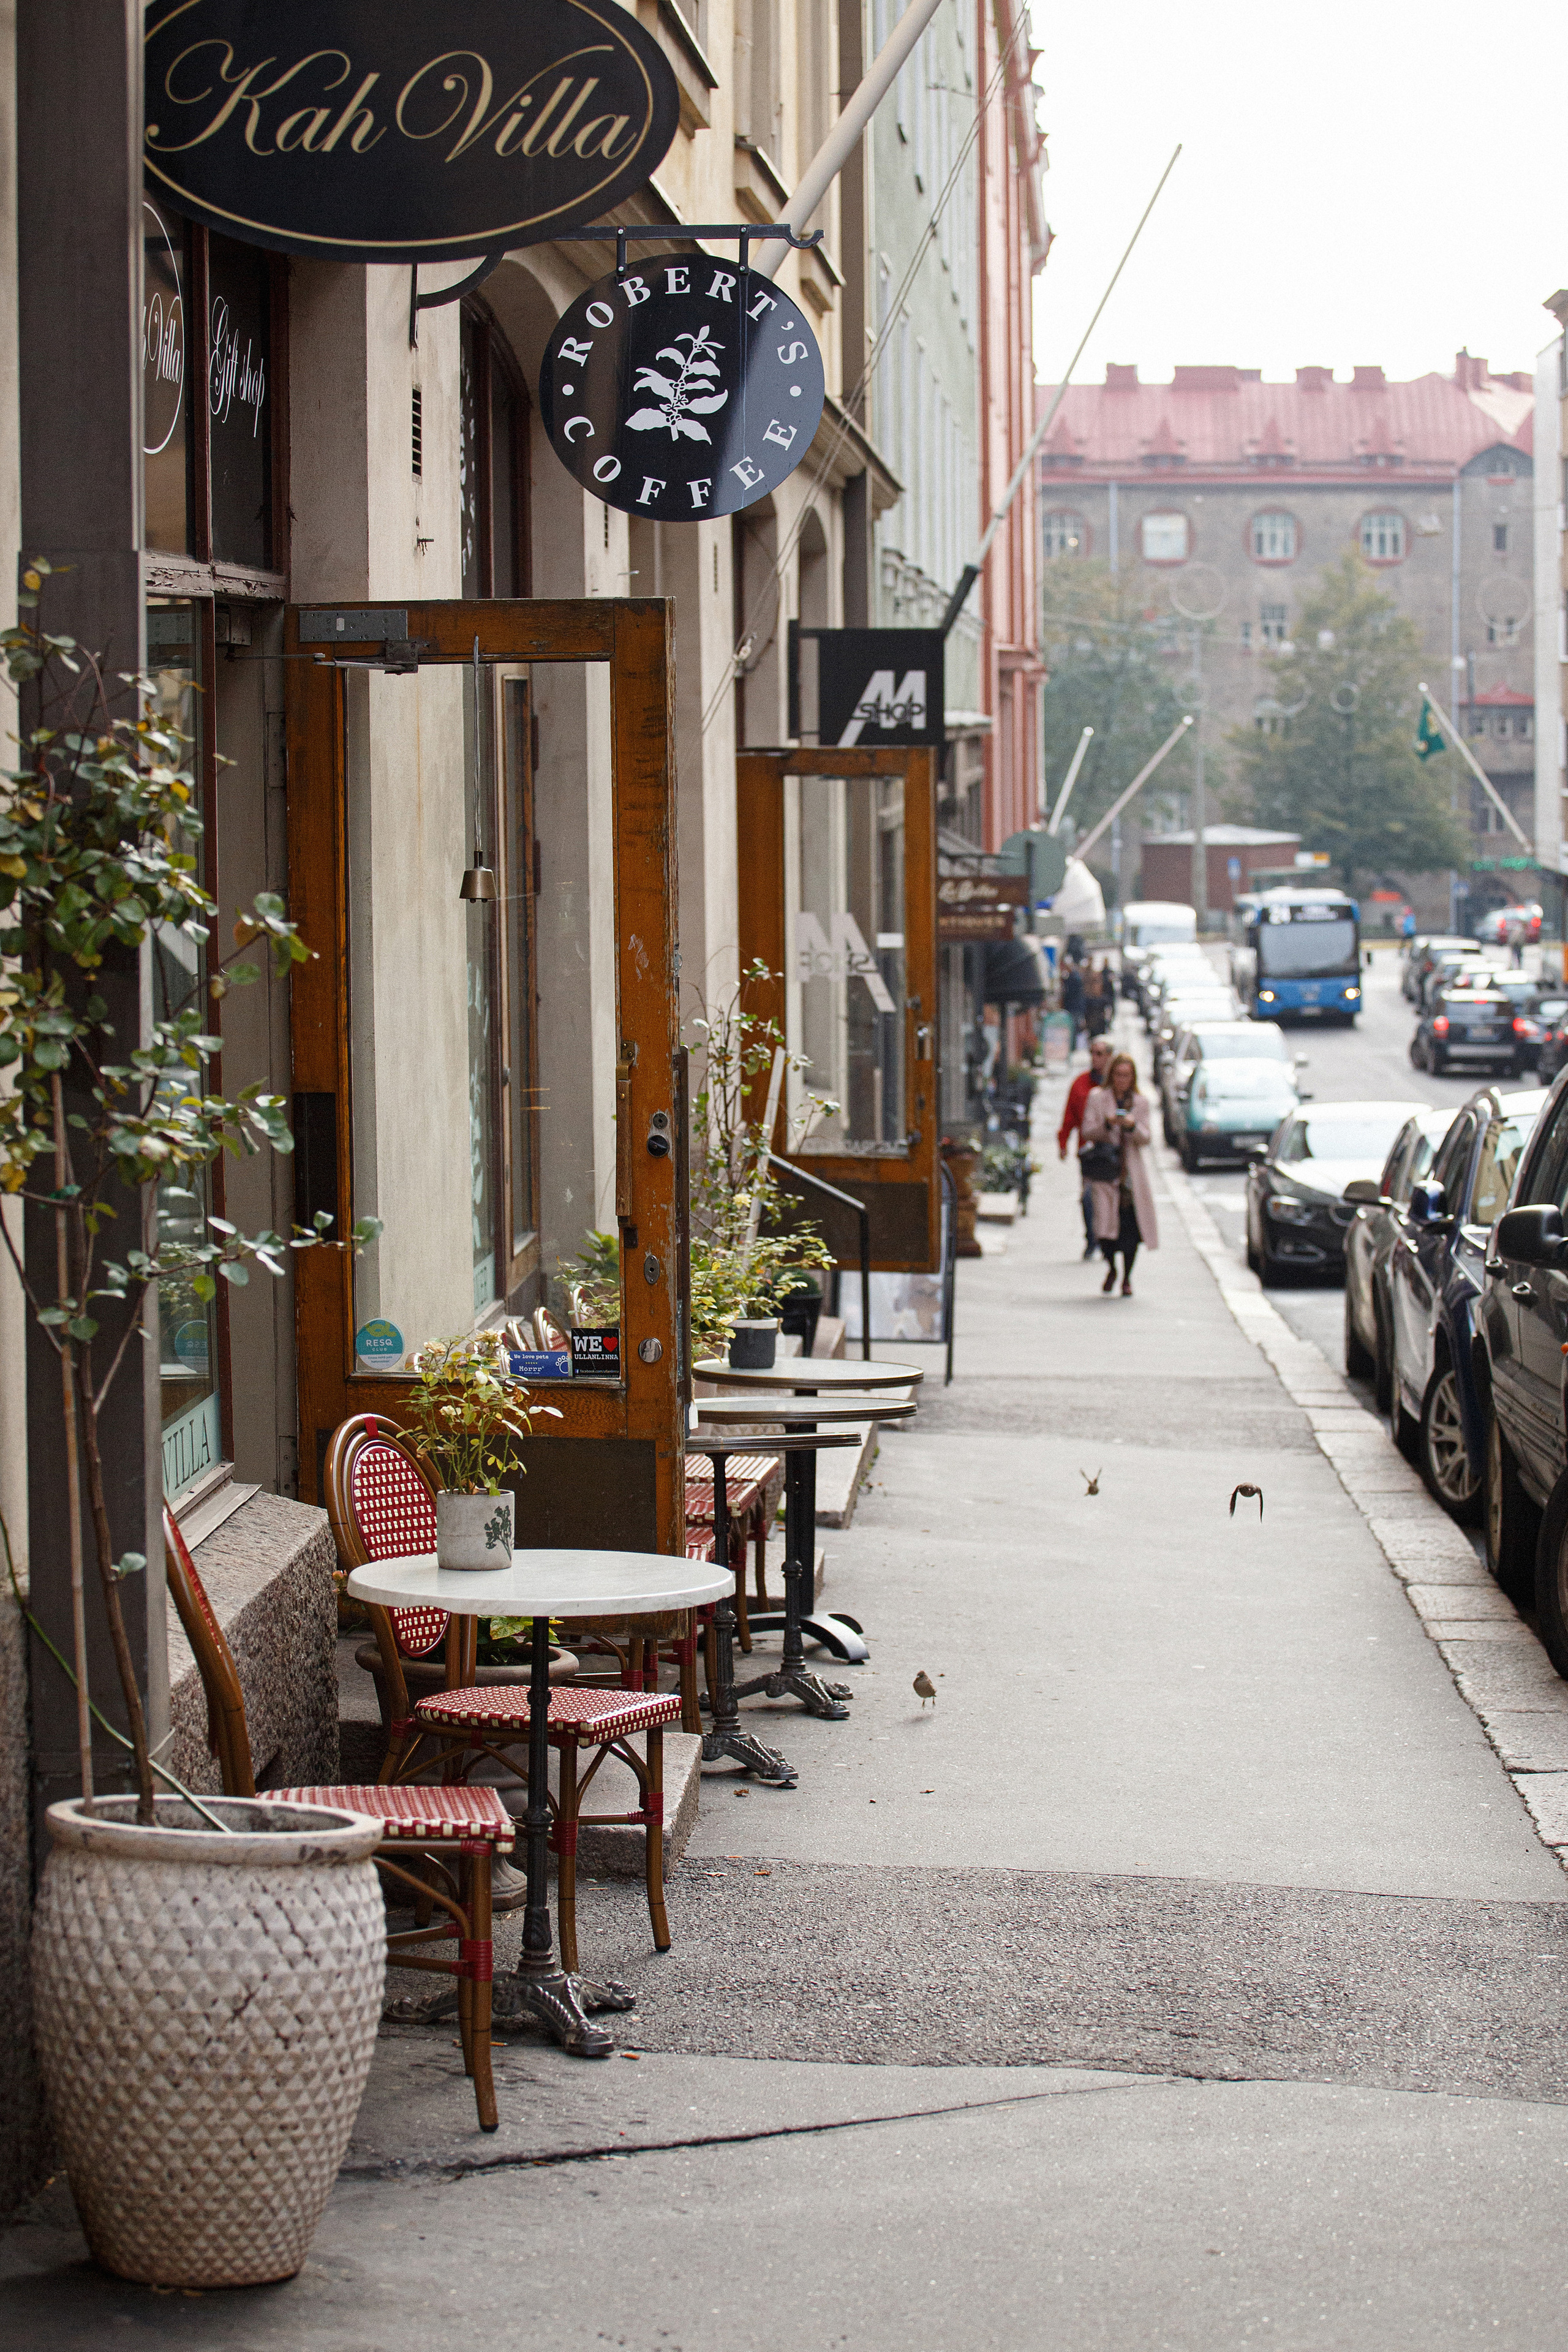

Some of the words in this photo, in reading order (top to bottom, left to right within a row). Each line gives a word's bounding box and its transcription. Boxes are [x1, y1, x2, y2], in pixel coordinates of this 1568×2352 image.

[145, 39, 388, 156] Kah
[396, 45, 638, 164] Villa
[148, 293, 182, 384] Villa
[557, 266, 809, 368] ROBERT'S
[209, 296, 239, 423] Gift
[239, 338, 265, 438] shop
[564, 416, 798, 508] COFFEE
[366, 1338, 394, 1347] RESQ
[573, 1336, 602, 1352] WE
[160, 1410, 211, 1496] VILLA
